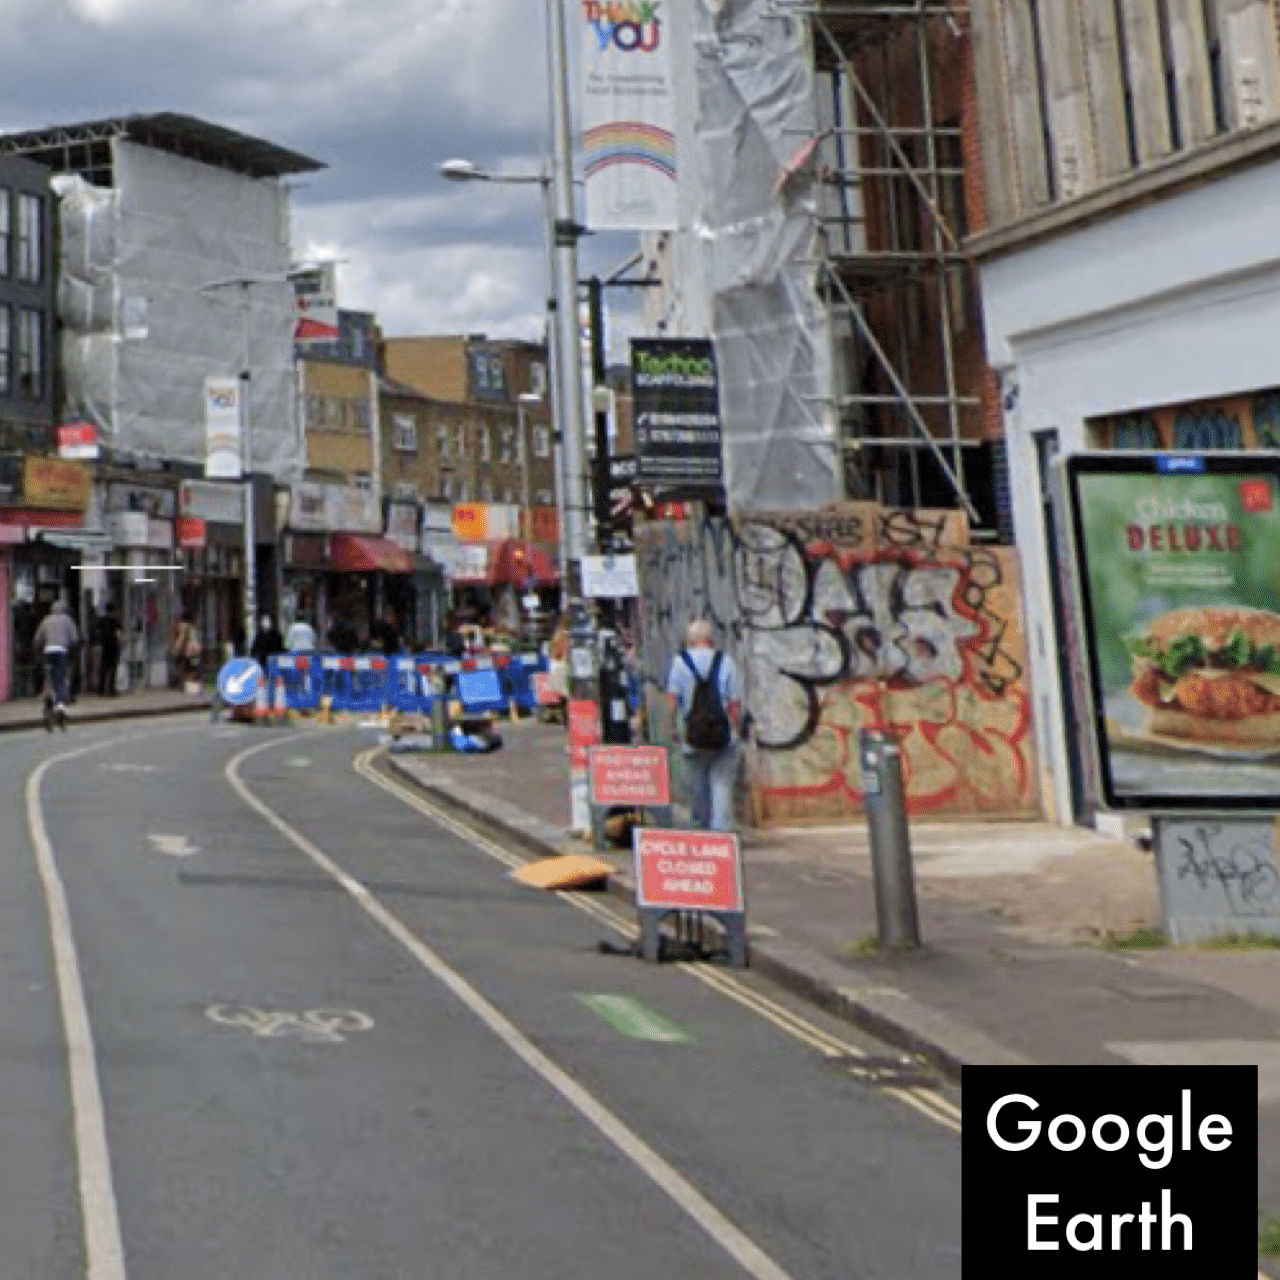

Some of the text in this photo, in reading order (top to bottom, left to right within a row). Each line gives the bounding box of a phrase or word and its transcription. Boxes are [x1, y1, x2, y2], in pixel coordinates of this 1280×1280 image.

[592, 19, 660, 52] YOU
[1126, 522, 1243, 553] DELUXE
[640, 839, 731, 858] CYCLE LANE
[656, 858, 718, 875] CLOSED
[661, 877, 715, 894] AHEAD
